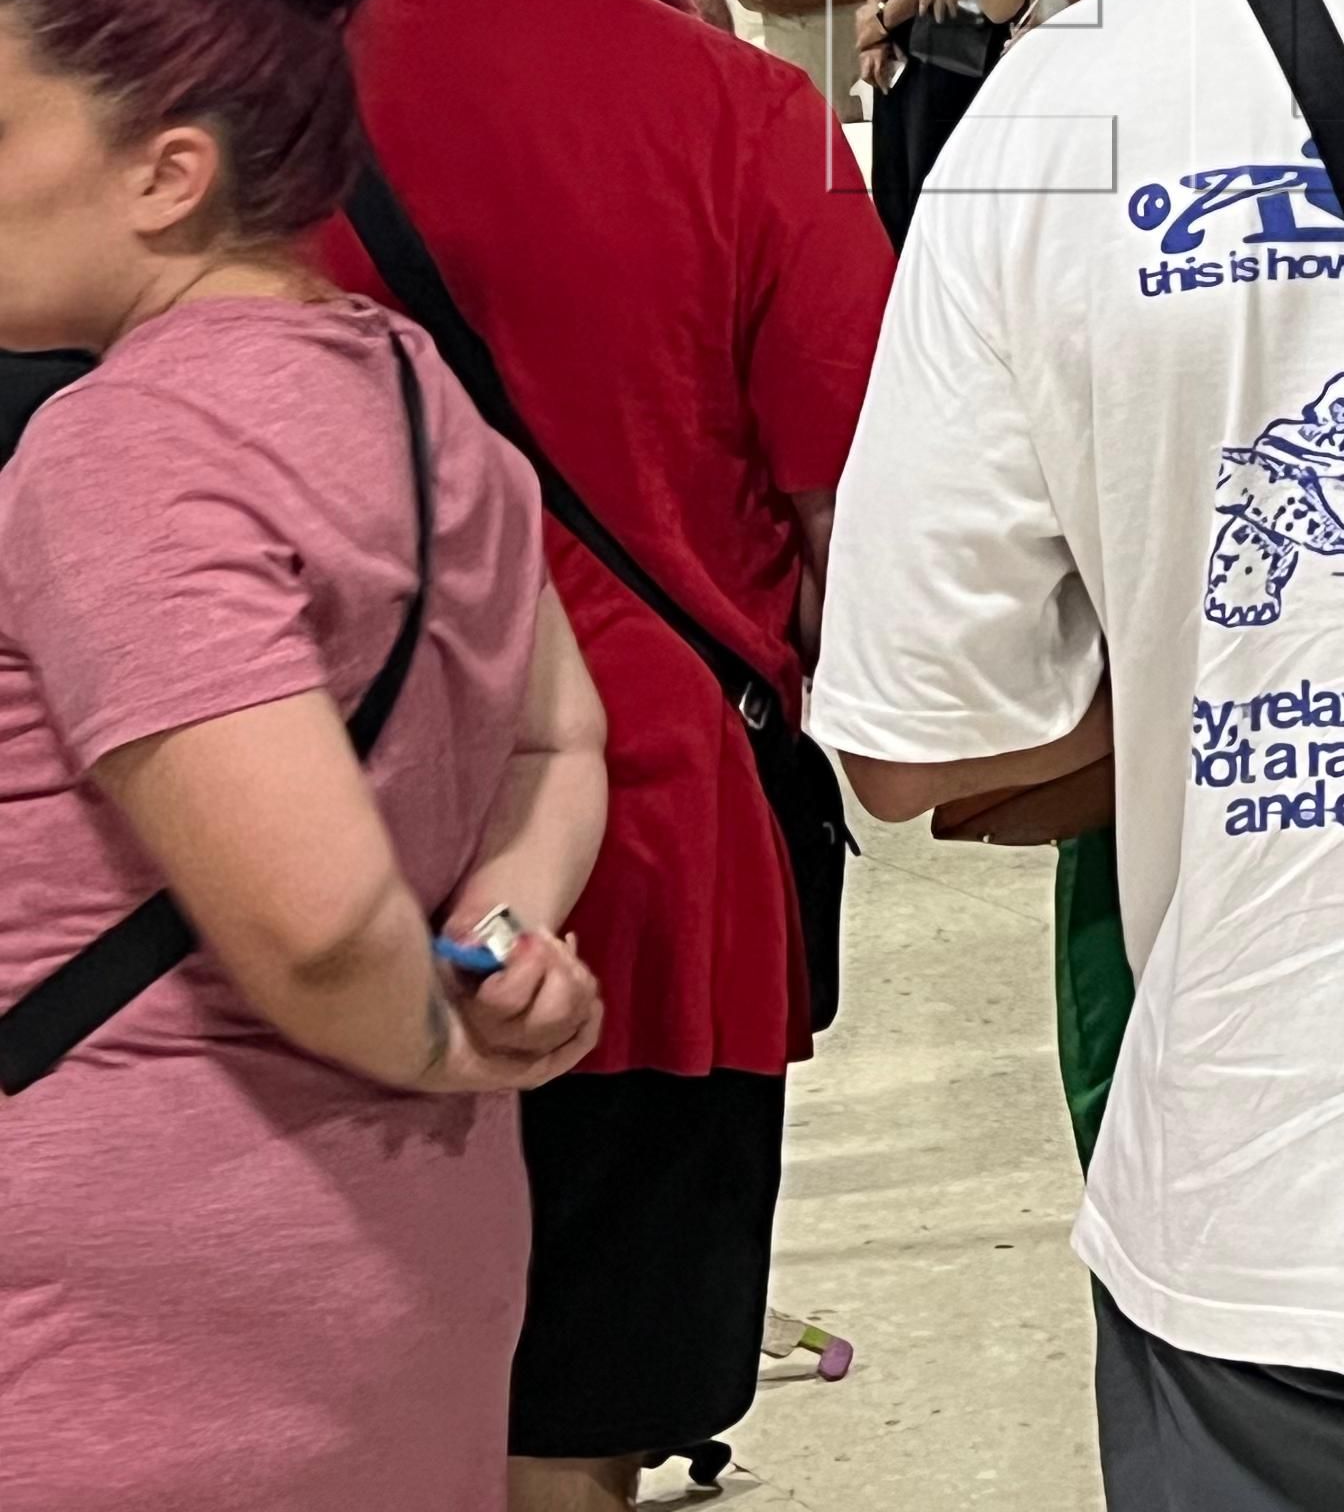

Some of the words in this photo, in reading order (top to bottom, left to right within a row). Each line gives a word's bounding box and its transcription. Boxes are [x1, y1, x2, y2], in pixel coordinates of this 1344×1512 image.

[1138, 255, 1225, 297] this
[1229, 249, 1260, 283] is
[1263, 742, 1298, 781] a
[1225, 779, 1326, 836] and
